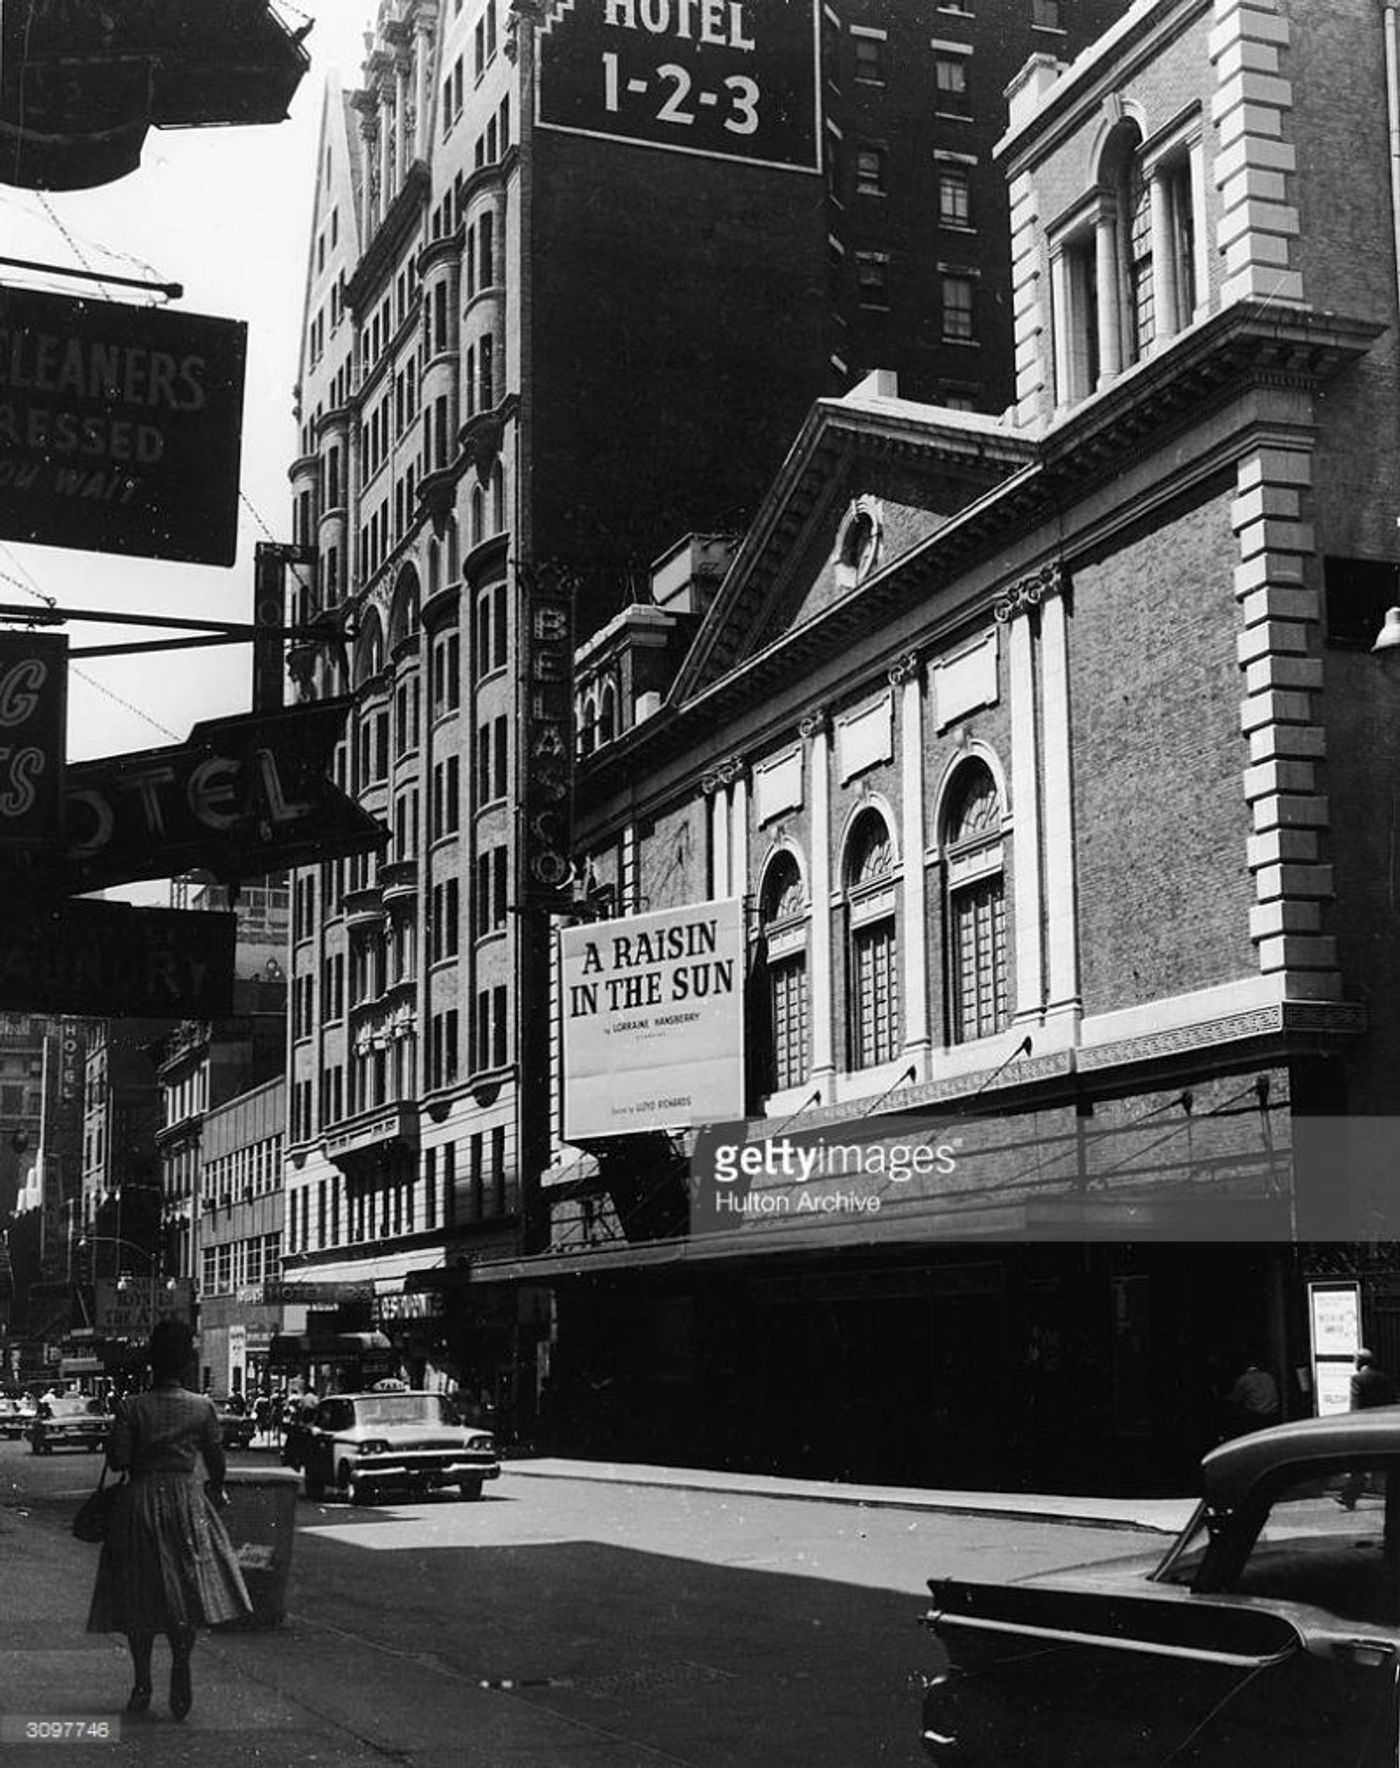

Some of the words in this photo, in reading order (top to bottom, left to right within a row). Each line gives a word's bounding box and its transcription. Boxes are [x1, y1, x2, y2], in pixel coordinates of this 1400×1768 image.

[602, 0, 756, 51] HOTEL
[602, 51, 760, 135] 1-2-3
[581, 942, 604, 975] A
[612, 919, 717, 970] RAISIN
[569, 981, 600, 1018] IN
[605, 972, 662, 1012] THE
[672, 958, 734, 1002] SUN
[612, 1019, 649, 1034] LORRAINE
[654, 1012, 701, 1027] HANSBERRY
[62, 1023, 77, 1100] HOTEL
